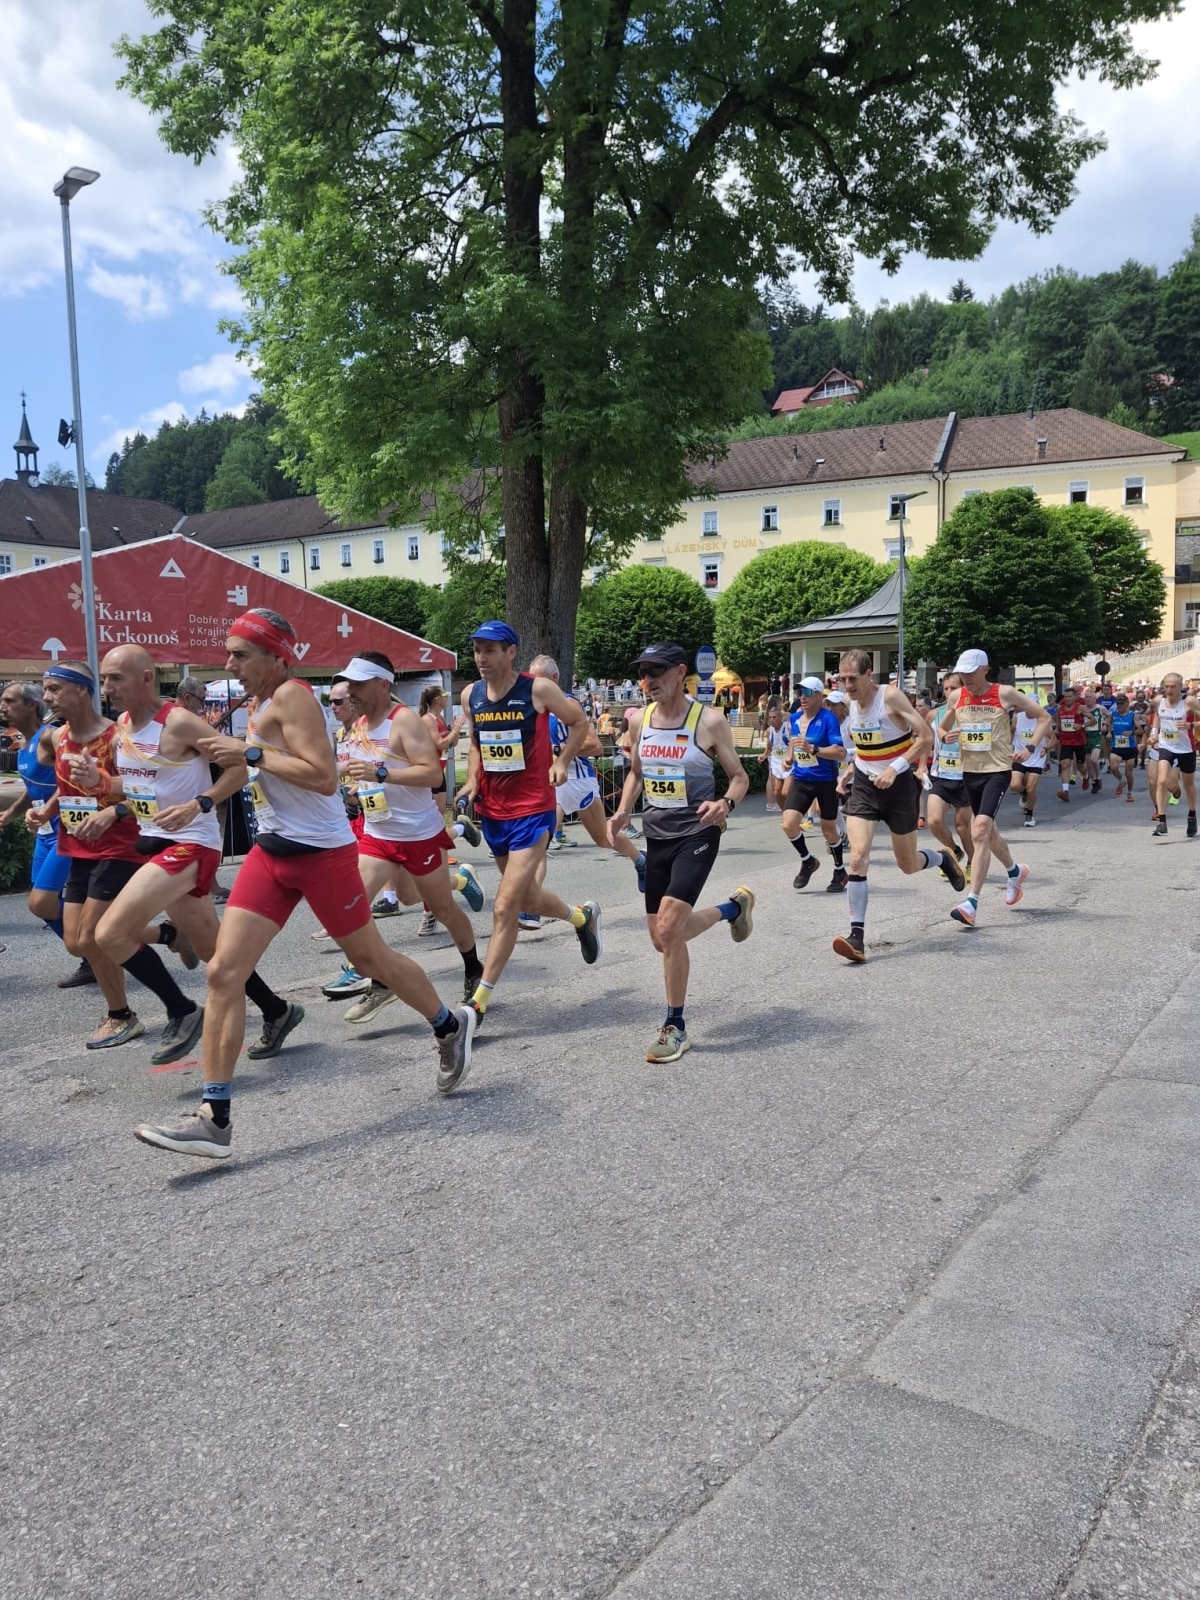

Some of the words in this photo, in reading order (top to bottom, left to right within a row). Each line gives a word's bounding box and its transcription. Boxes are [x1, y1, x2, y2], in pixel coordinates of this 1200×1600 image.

[733, 537, 757, 549] DŮM
[98, 602, 153, 623] Karta
[189, 614, 219, 624] Dobře
[98, 625, 179, 645] Krkonoš
[190, 638, 208, 647] pod
[474, 711, 525, 723] ROMANIA
[857, 732, 873, 741] 147
[967, 733, 984, 741] 895
[489, 745, 513, 758] 500
[641, 744, 687, 759] GERMANY
[651, 781, 676, 794] 254
